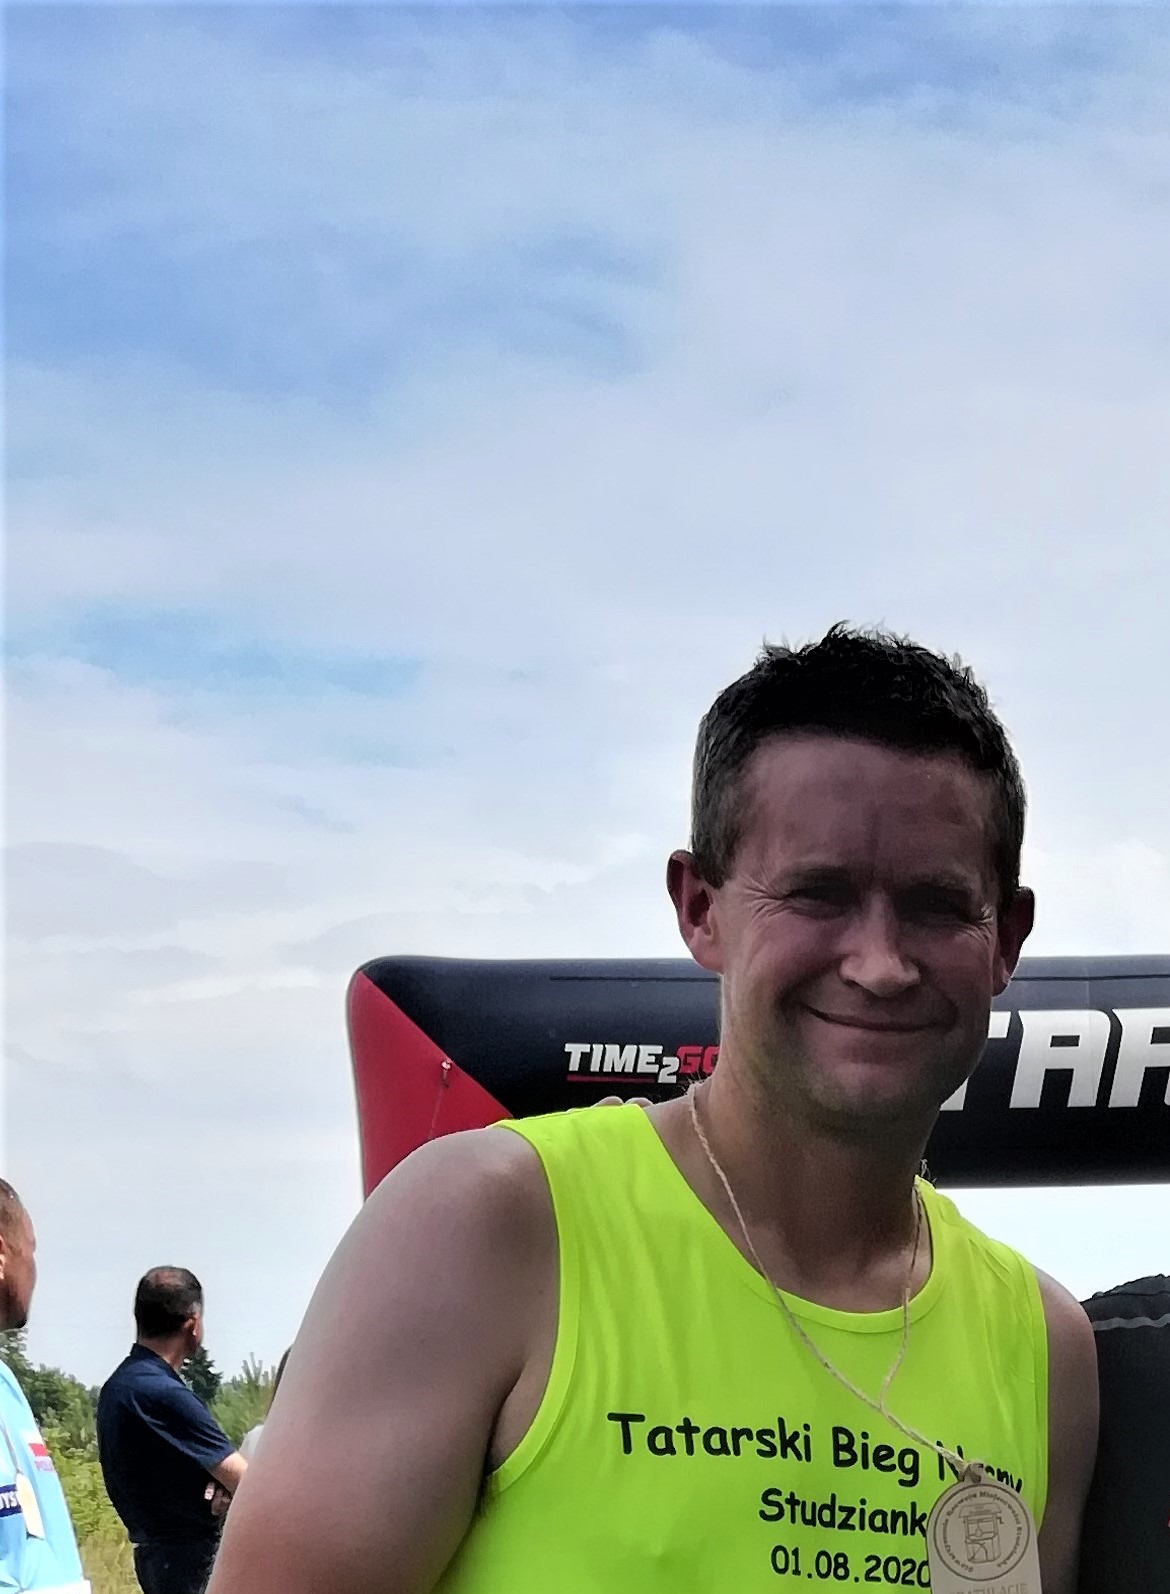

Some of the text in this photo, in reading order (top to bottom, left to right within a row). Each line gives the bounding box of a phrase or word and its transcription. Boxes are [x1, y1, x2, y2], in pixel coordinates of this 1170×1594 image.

[607, 1412, 812, 1463] Tatarski
[832, 1425, 920, 1488] Bieg
[758, 1487, 928, 1538] Studziank
[771, 1545, 931, 1588] 01.08.2020
